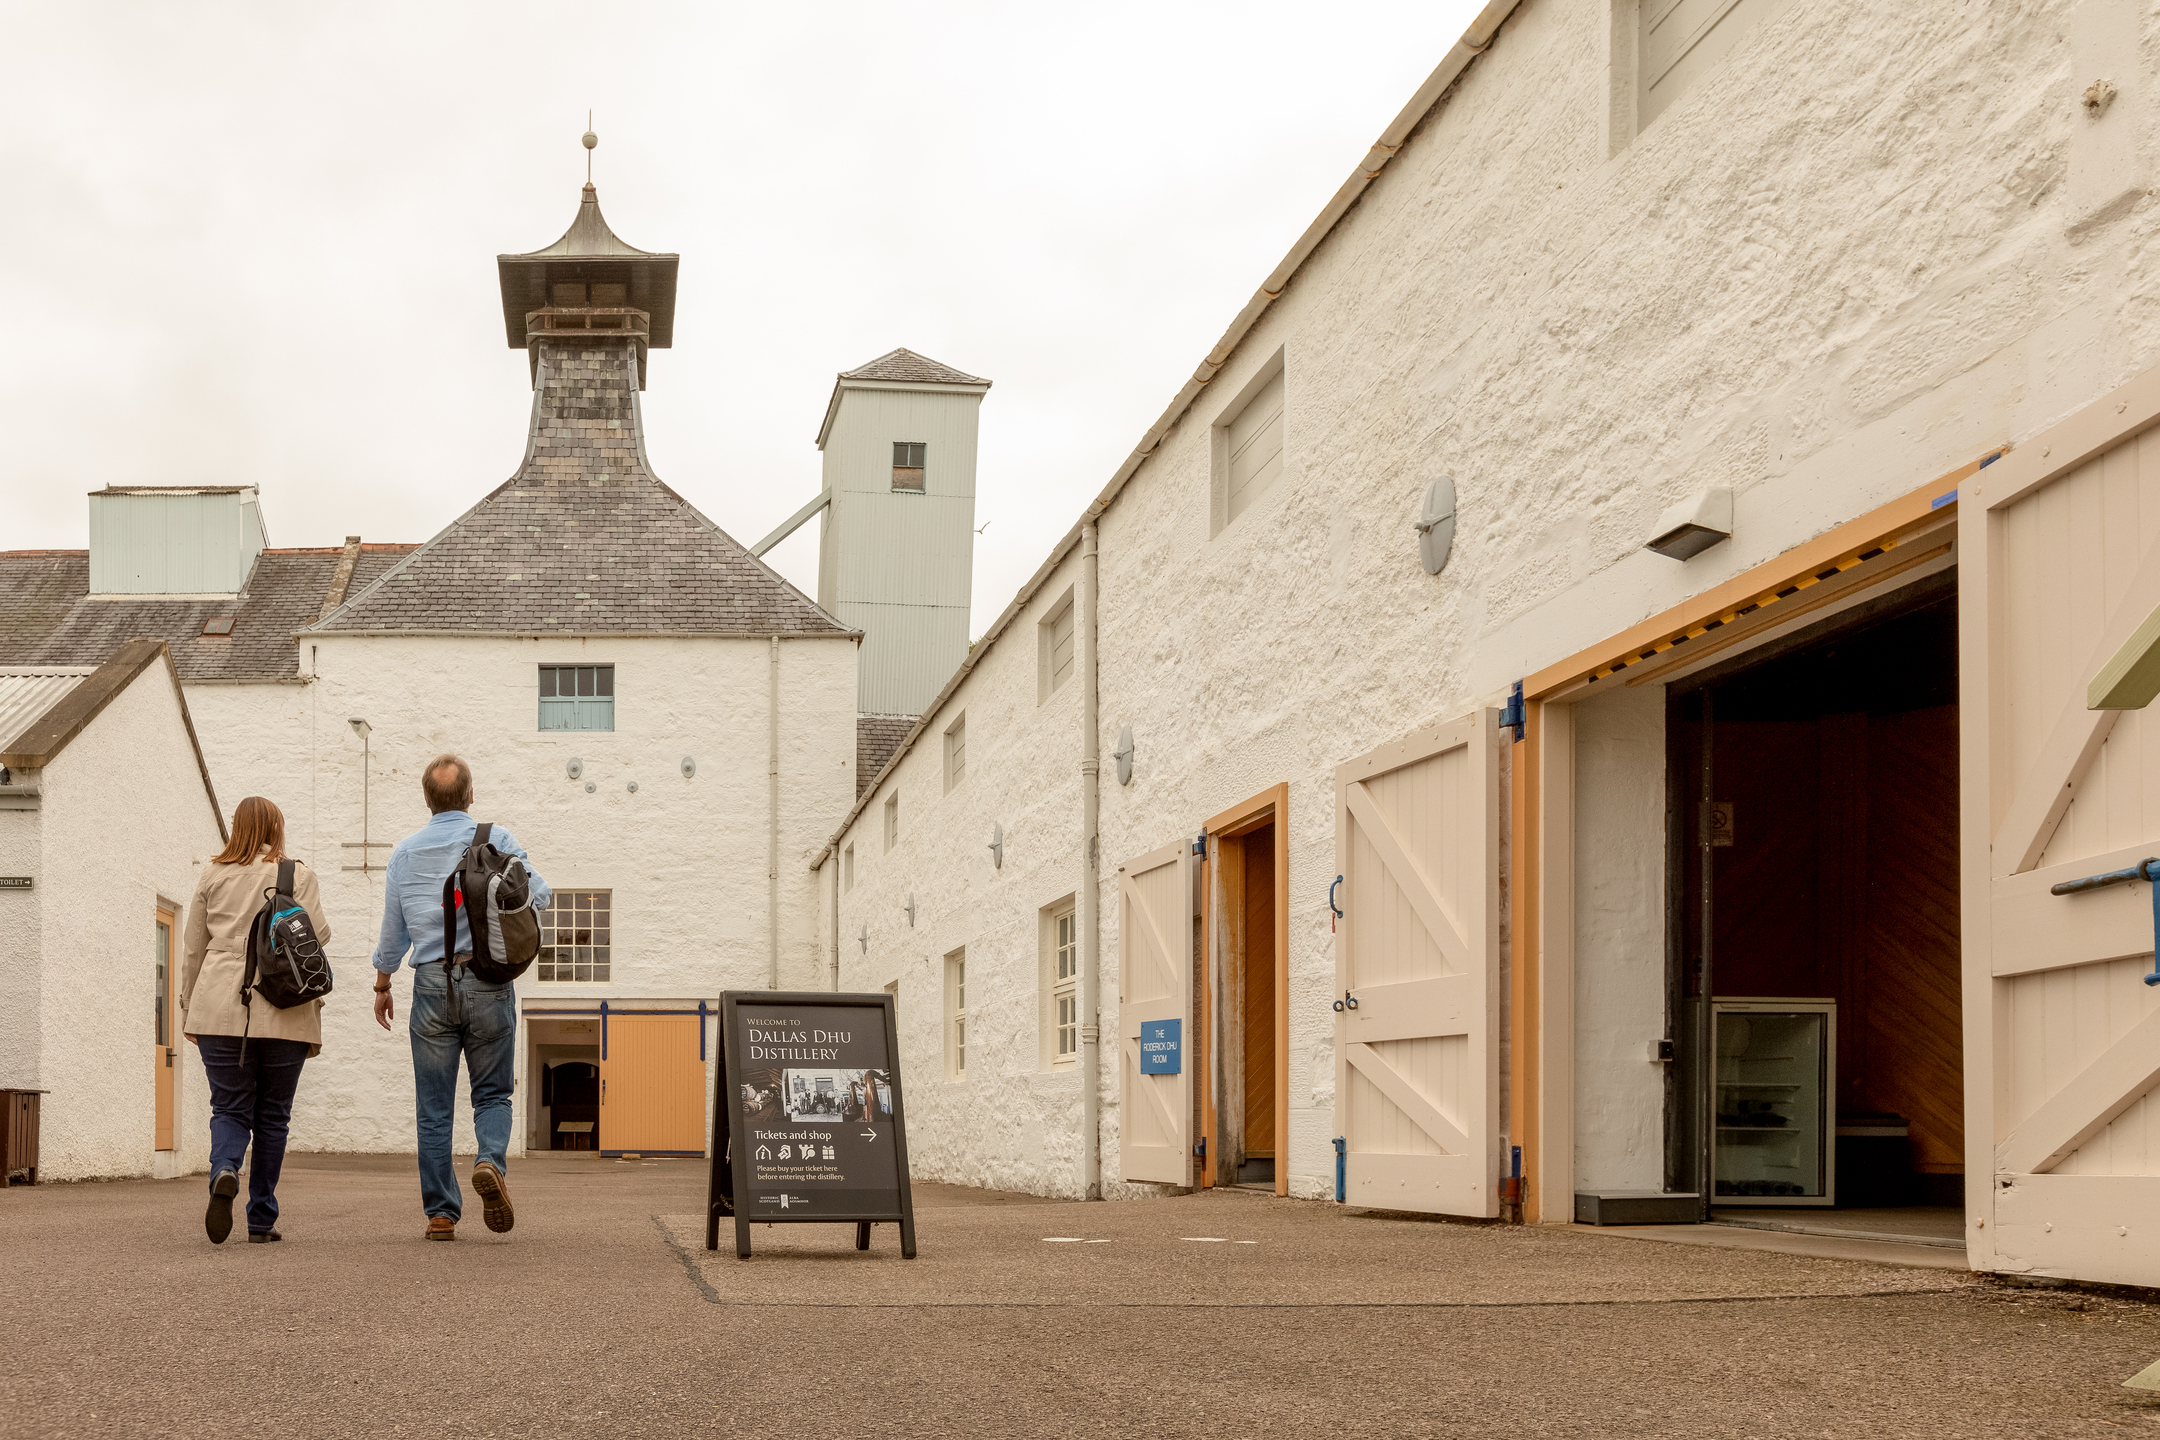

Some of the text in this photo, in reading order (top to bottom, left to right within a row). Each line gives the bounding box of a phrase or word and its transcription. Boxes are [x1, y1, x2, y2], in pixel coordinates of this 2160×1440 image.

[746, 1018, 788, 1026] WELCOME
[748, 1028, 852, 1044] DALLAS DHU
[1155, 1029, 1165, 1038] THE
[1143, 1041, 1178, 1052] RODERICK DHU
[749, 1045, 839, 1060] DISTILLERY
[1152, 1054, 1168, 1064] ROOM
[754, 1130, 832, 1142] Tickets and shop
[777, 1165, 790, 1173] buy
[778, 1174, 806, 1182] entering
[817, 1173, 846, 1182] distillery.
